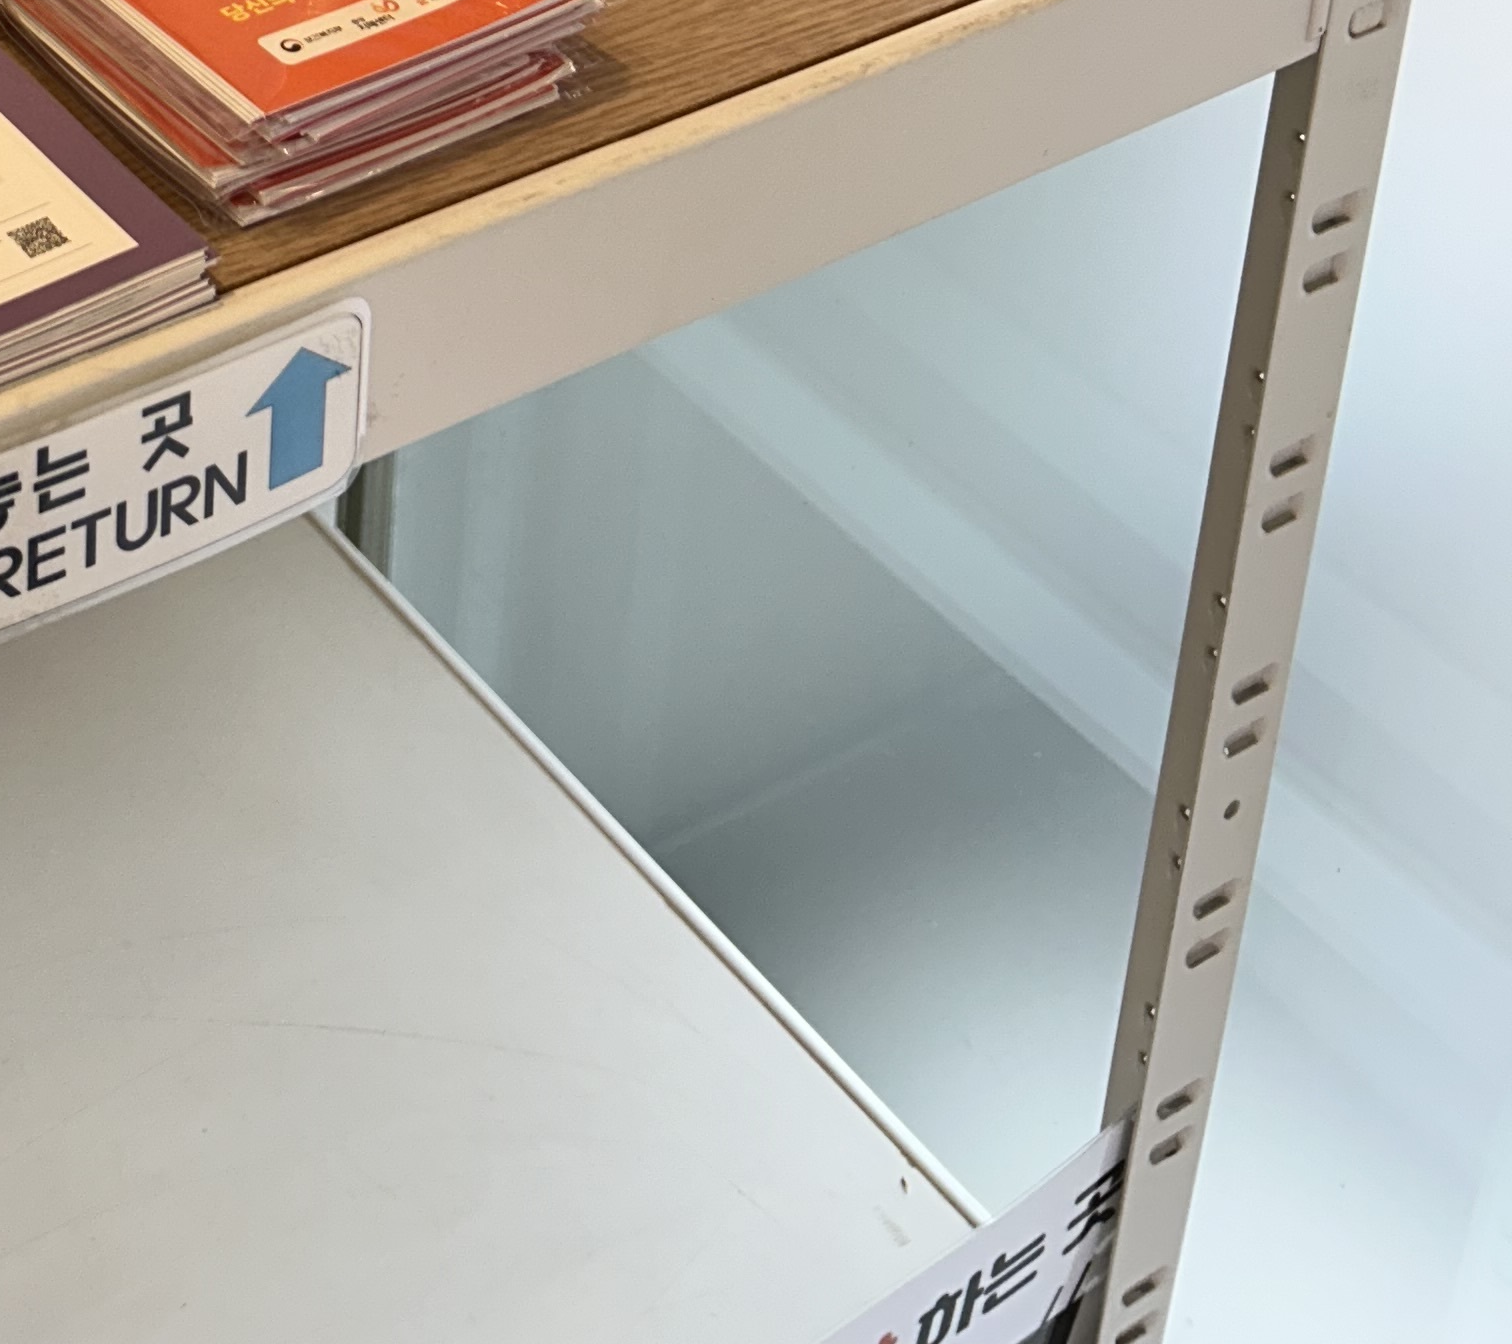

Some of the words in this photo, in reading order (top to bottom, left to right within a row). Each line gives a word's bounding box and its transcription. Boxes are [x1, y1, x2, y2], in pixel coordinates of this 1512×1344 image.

[141, 390, 192, 472] 곳
[916, 1234, 1047, 1344] 하는
[1063, 1160, 1124, 1255] 곳
